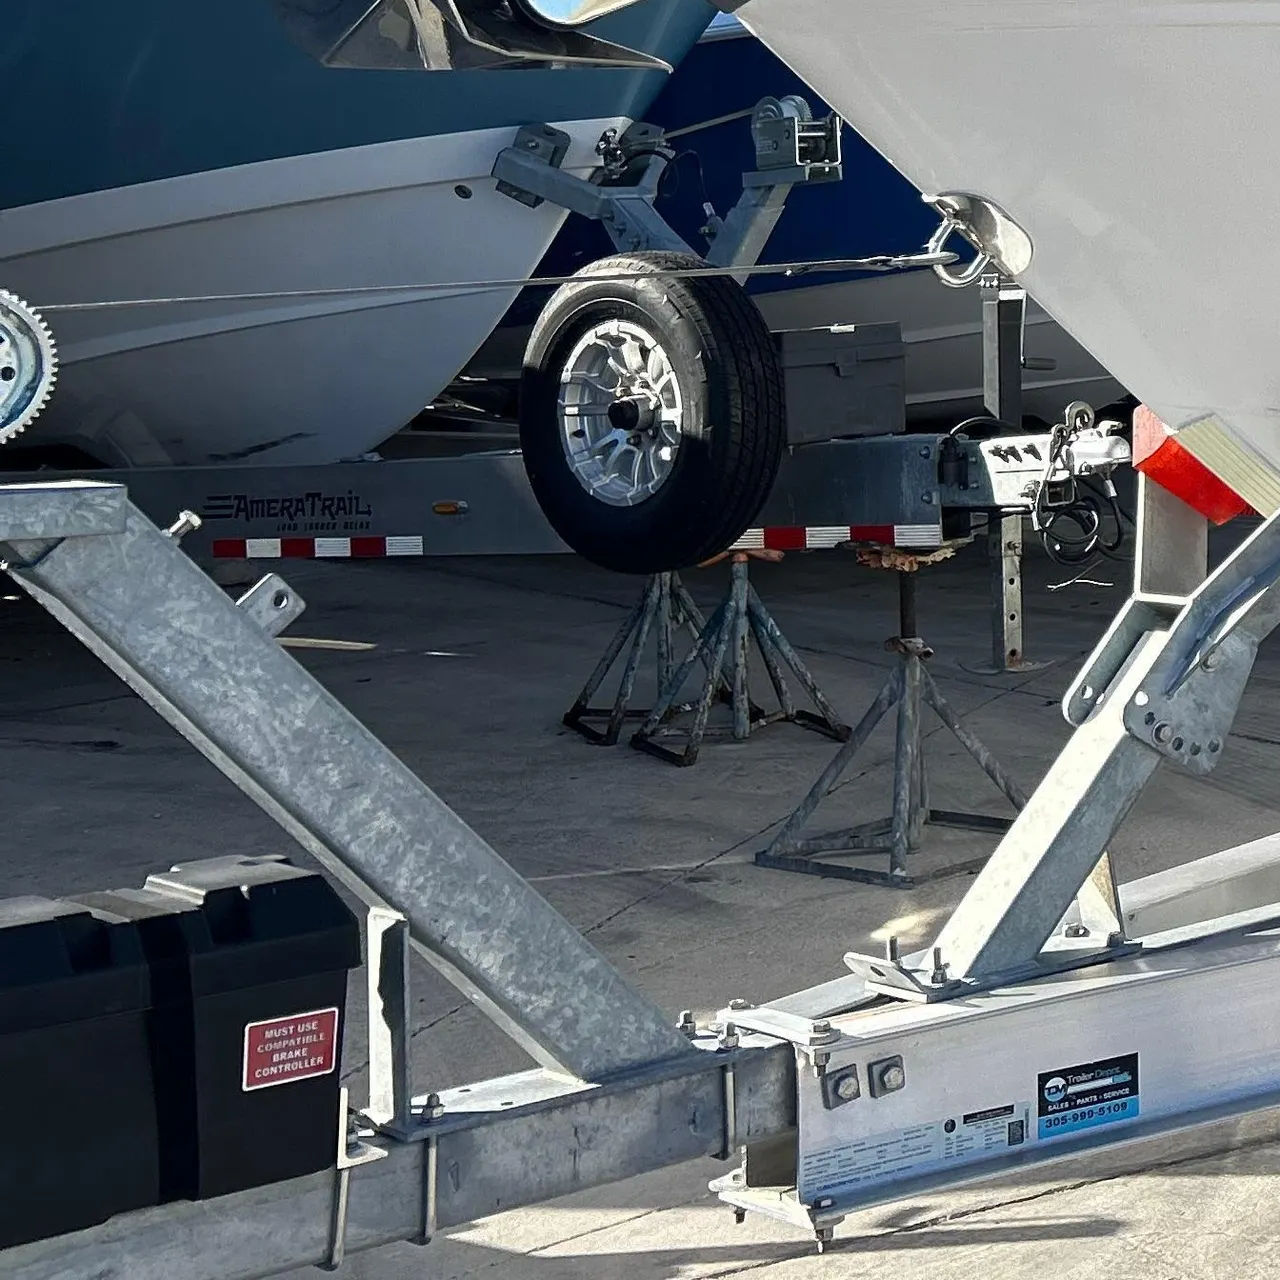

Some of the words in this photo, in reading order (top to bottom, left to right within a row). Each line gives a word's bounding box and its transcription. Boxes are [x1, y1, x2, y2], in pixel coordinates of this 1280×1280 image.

[264, 1025, 295, 1039] MUST
[297, 1021, 319, 1033] USE
[257, 1032, 325, 1053] COMPATIBLE
[272, 1047, 308, 1063] BRAKE
[255, 1056, 324, 1078] CONTROLLER
[1048, 1101, 1069, 1112] SALES
[1076, 1095, 1098, 1106] PARTS
[1103, 1087, 1130, 1100] SERVICE
